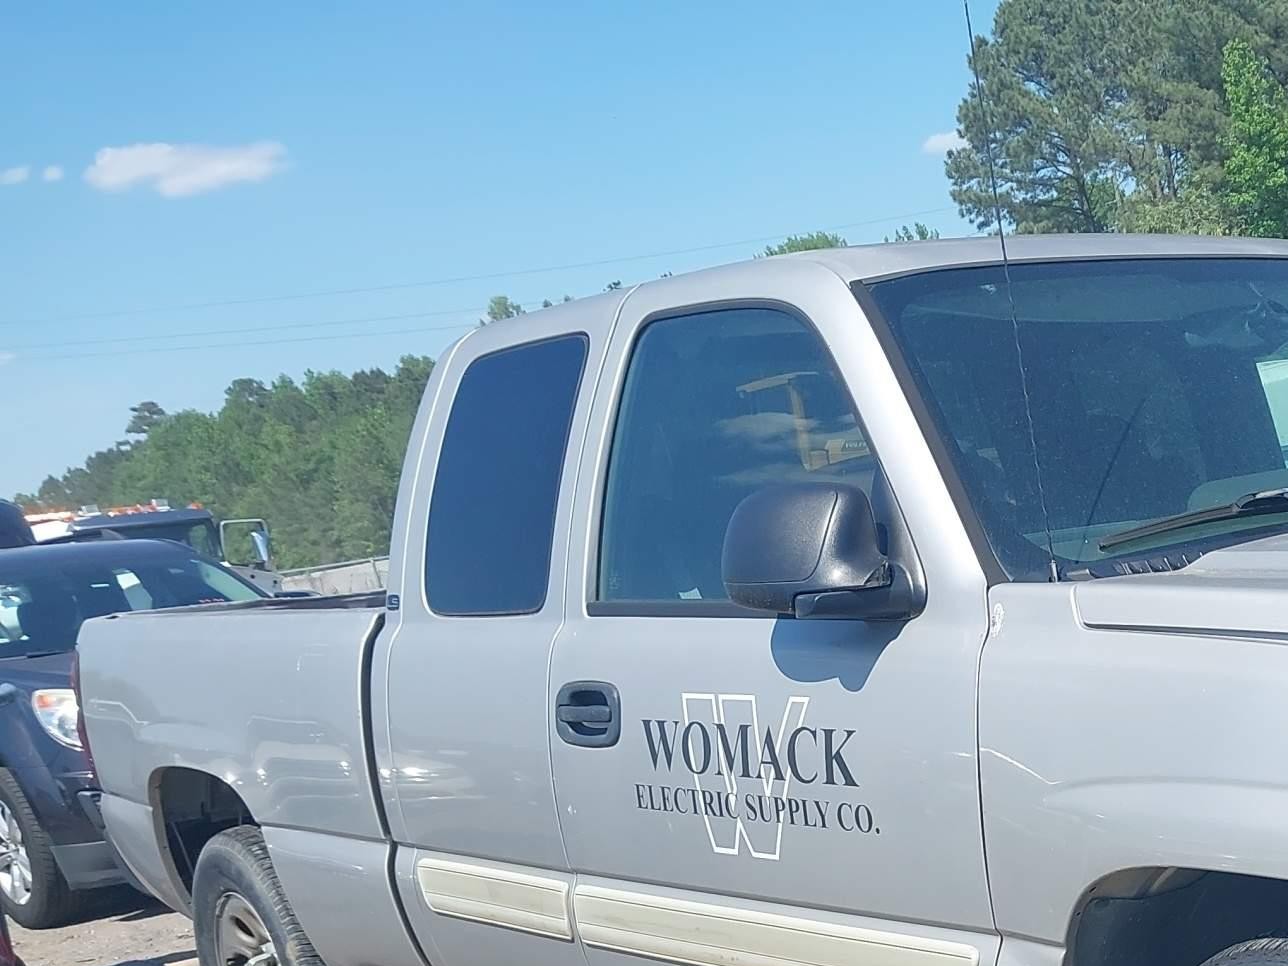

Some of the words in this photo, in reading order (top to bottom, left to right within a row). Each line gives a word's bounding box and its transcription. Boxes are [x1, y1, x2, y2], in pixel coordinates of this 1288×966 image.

[641, 719, 861, 788] WOMACK
[634, 783, 740, 820] ELECTRIC
[745, 793, 830, 829] SUPPLY
[836, 802, 881, 834] CO.
